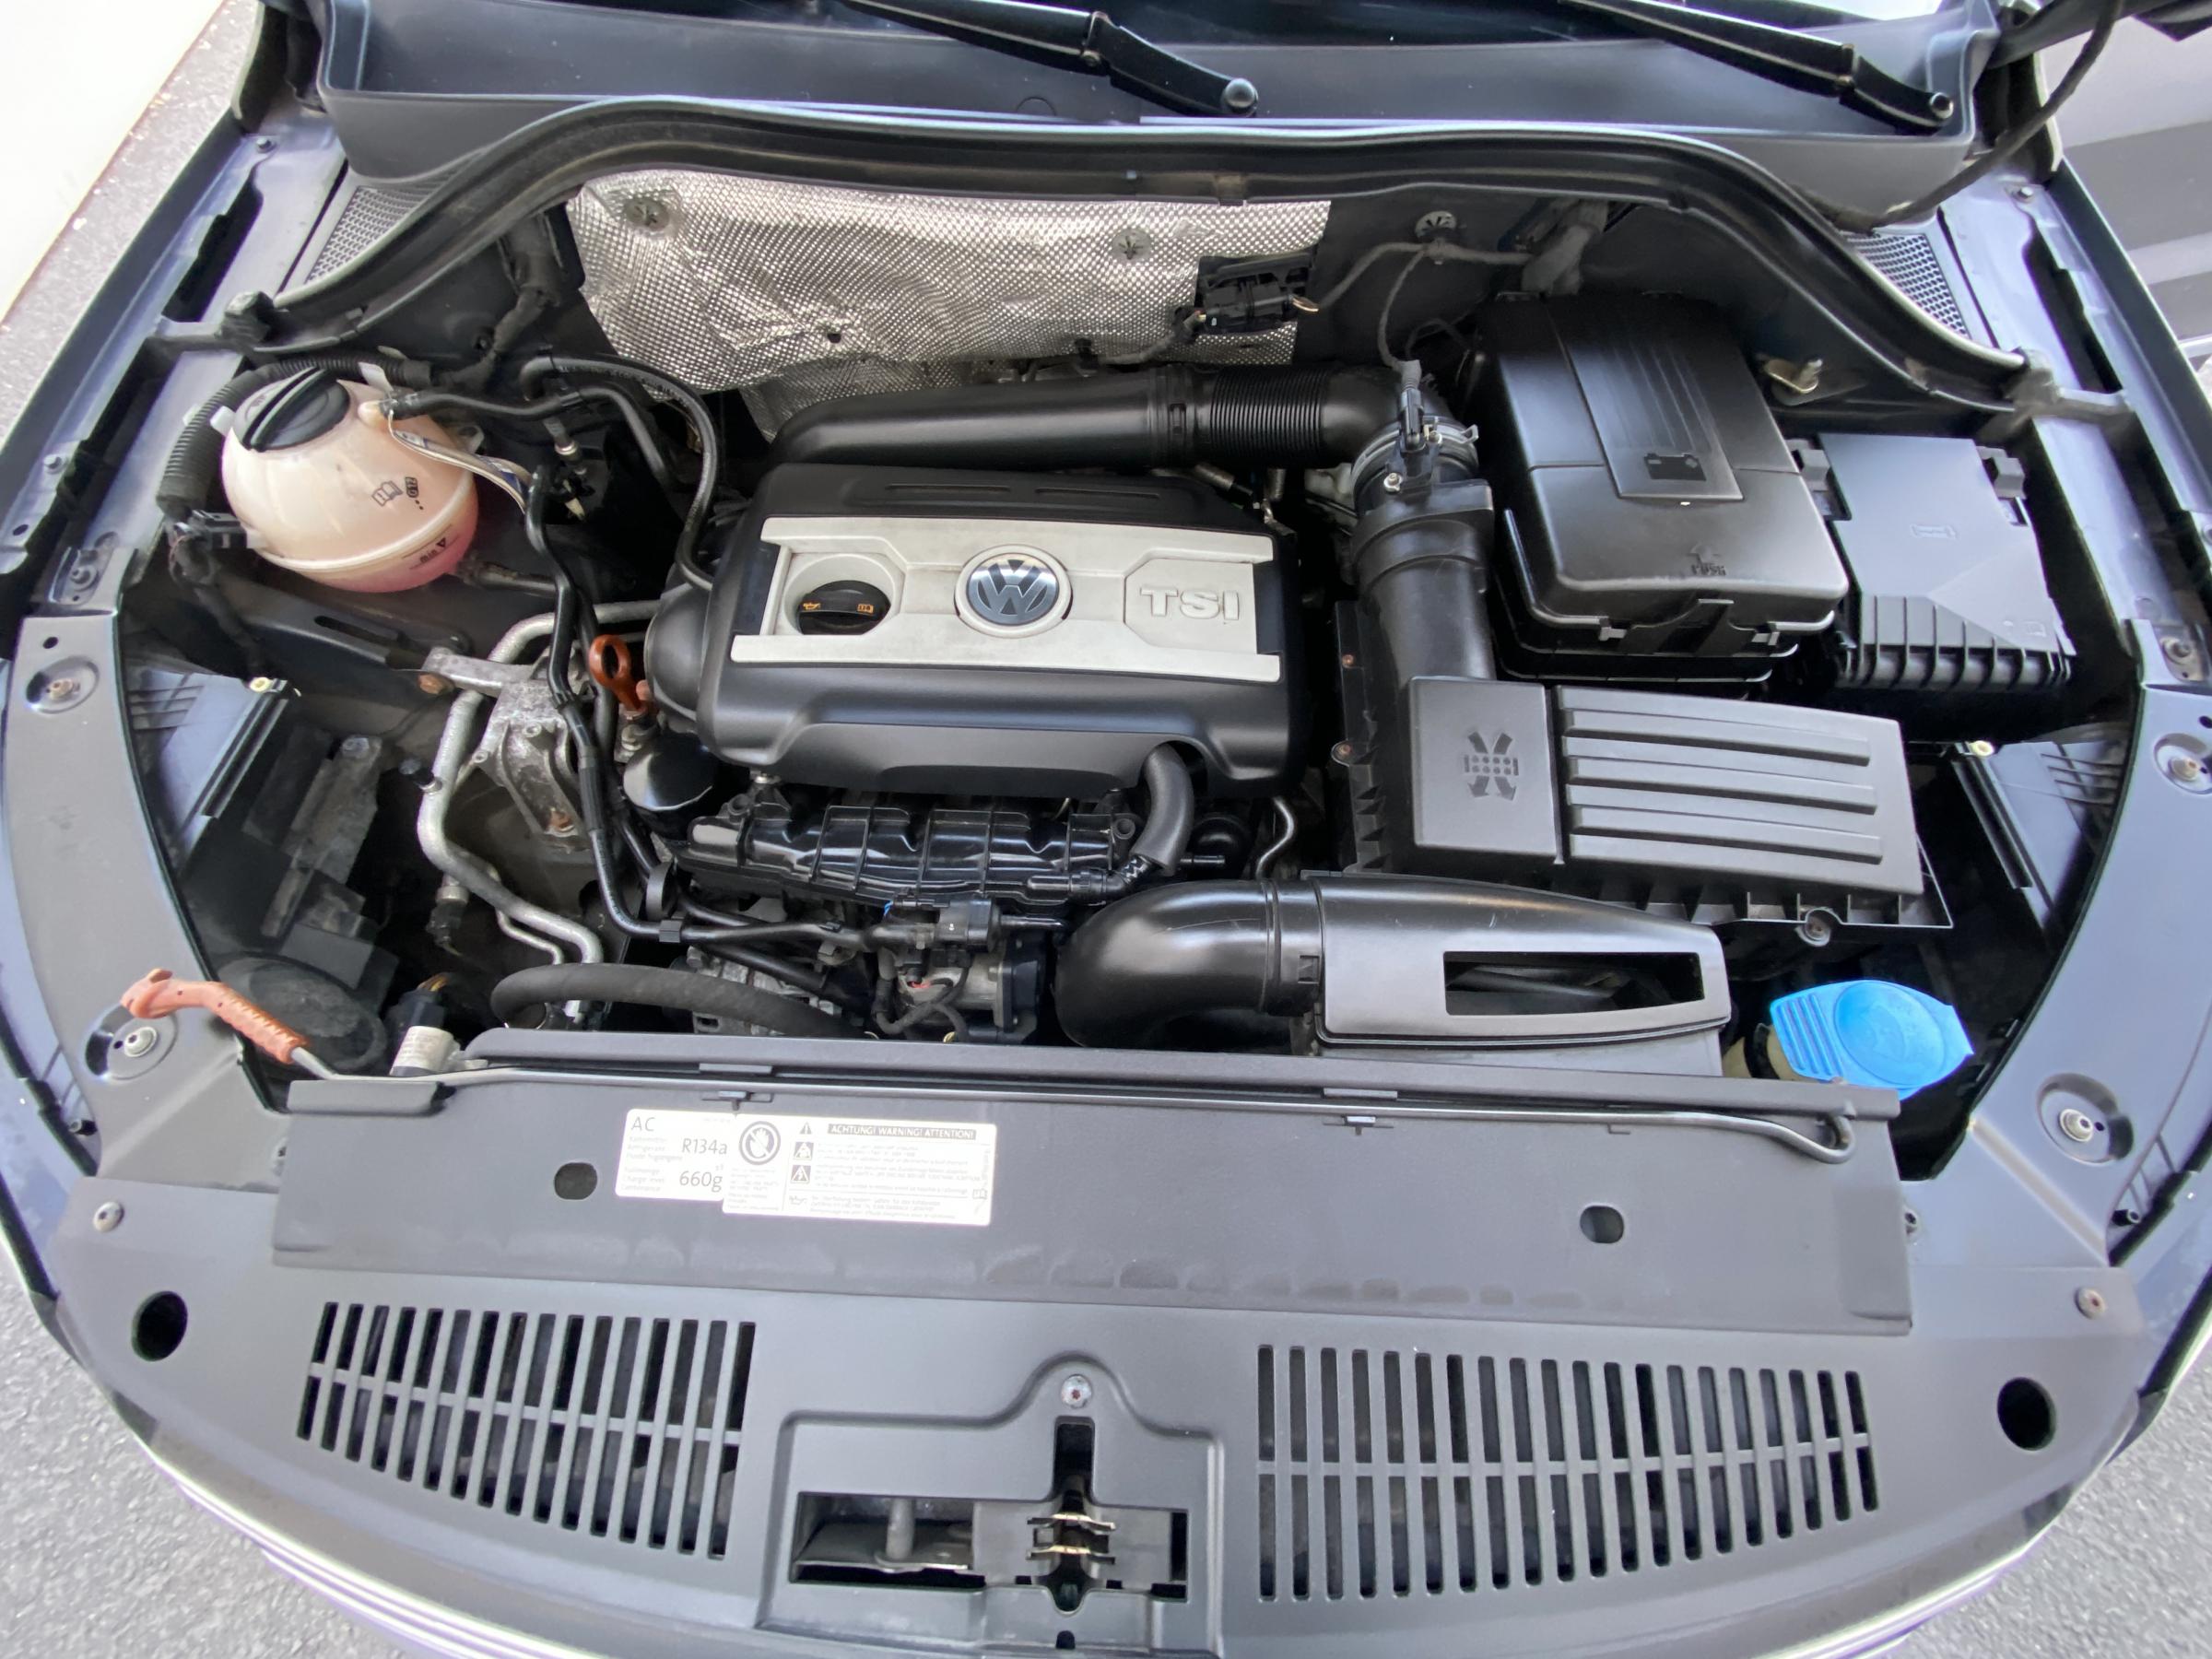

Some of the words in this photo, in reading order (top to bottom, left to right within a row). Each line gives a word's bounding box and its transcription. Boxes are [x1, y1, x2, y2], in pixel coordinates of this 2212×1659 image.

[1139, 587, 1240, 620] TSI
[631, 1116, 655, 1132] AC
[831, 1125, 877, 1135] ACHTUNG!
[878, 1127, 923, 1137] WARNING!
[924, 1129, 974, 1139] ATTENTION!
[682, 1138, 728, 1155] R134a
[679, 1171, 724, 1194] 660g
